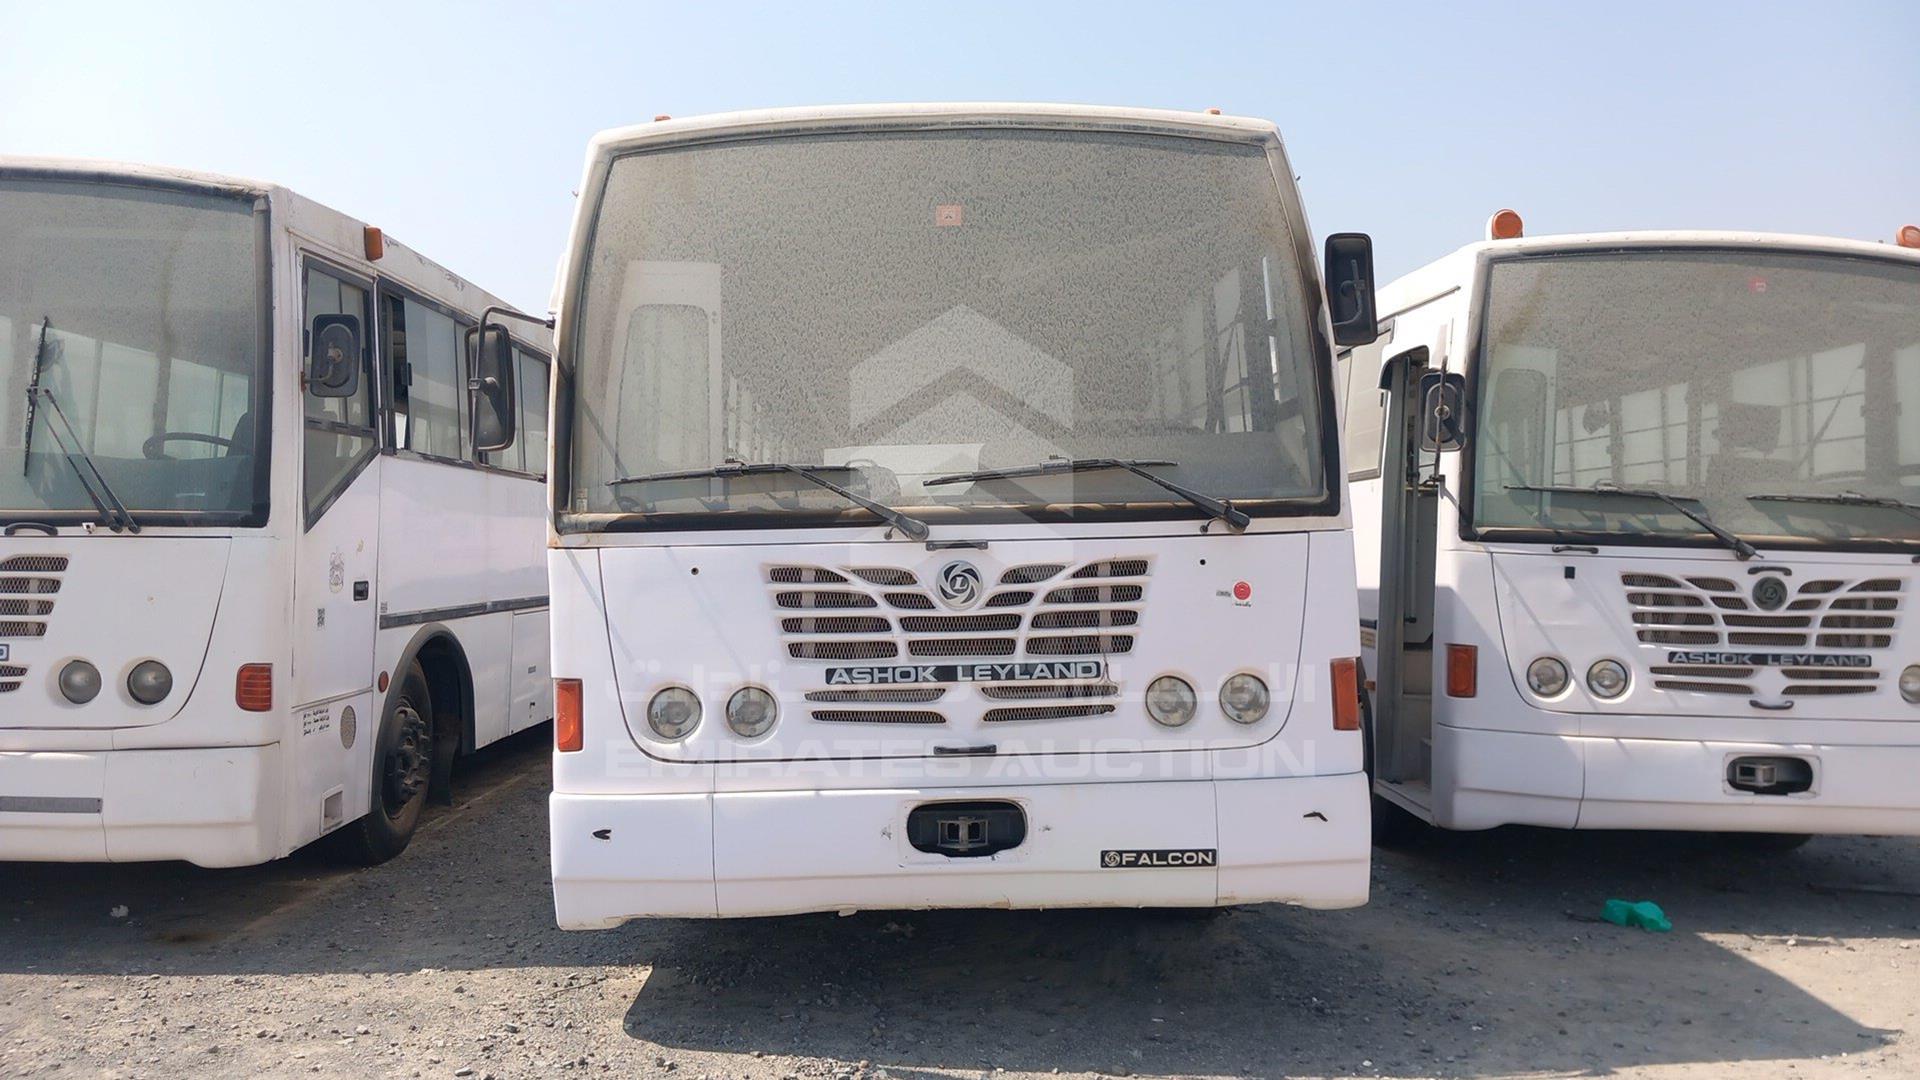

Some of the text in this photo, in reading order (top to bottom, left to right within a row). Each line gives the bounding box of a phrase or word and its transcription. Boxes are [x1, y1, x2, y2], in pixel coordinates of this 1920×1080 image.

[1672, 652, 1869, 667] ASHOK LEYLAND
[830, 661, 1098, 684] ASHOK LEYLAND
[1121, 852, 1213, 866] FALCON
